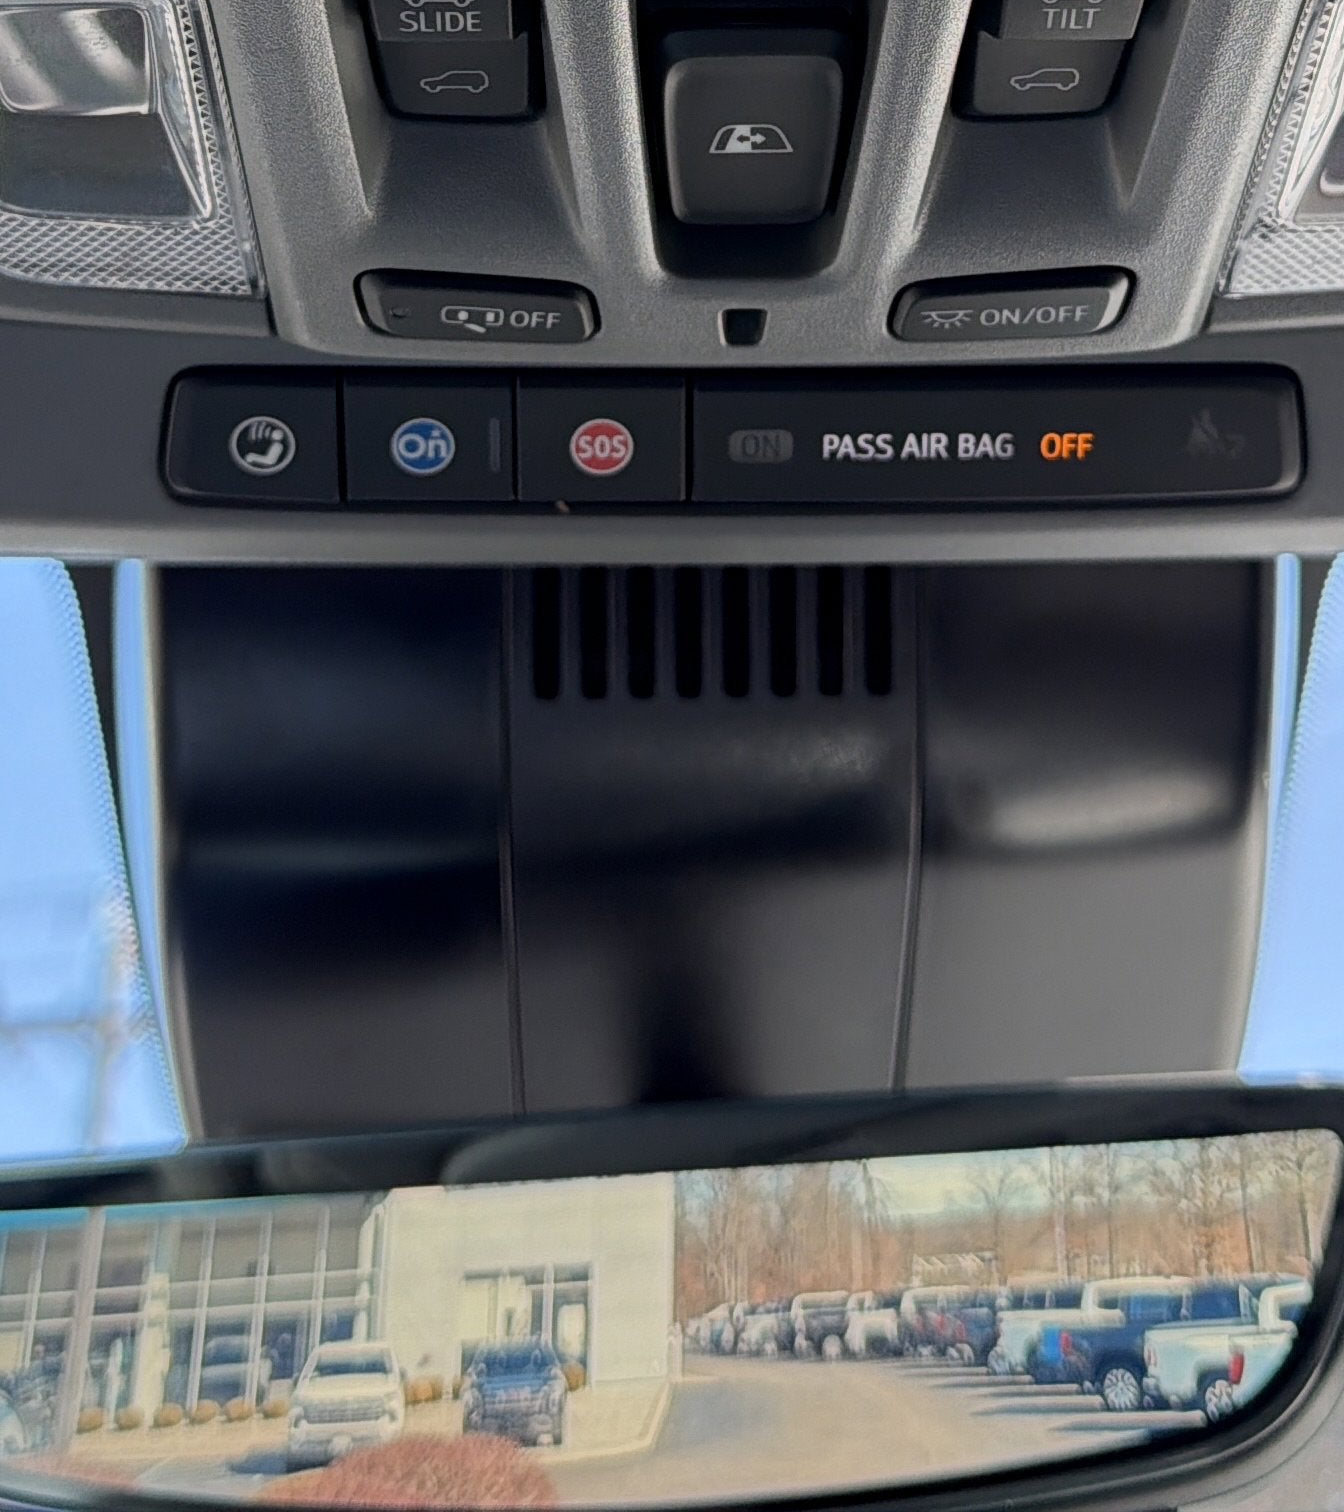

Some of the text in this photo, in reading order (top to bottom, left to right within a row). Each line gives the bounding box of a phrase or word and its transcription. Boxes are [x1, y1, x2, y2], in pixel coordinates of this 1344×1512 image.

[399, 10, 482, 33] SLIDE
[1042, 7, 1102, 30] TILT
[509, 310, 561, 329] OFF
[979, 304, 1089, 326] ON/OFF
[576, 433, 629, 459] SOS
[740, 432, 1094, 461] ON PASS AIR BAG OFF
